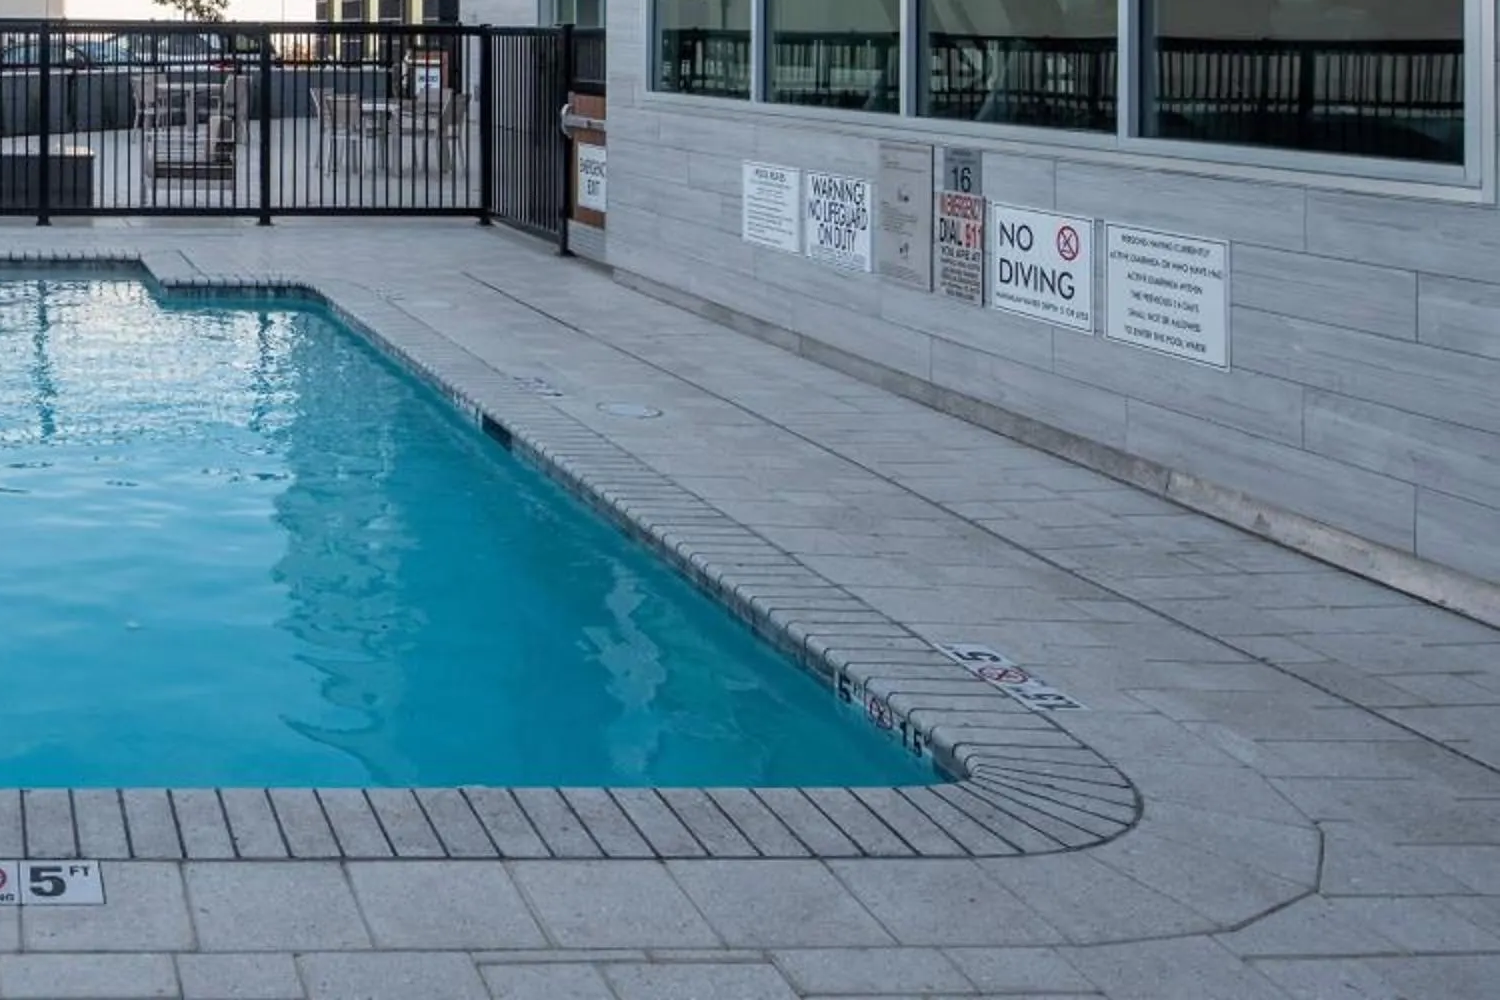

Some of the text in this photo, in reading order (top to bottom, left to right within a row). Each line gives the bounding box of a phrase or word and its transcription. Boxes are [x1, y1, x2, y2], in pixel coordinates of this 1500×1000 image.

[951, 166, 972, 193] 16
[808, 199, 821, 220] NO
[818, 223, 857, 252] ON DUTY
[940, 217, 962, 246] DIAL
[1000, 221, 1033, 251] NO
[1000, 257, 1075, 300] DIVING
[29, 866, 90, 897] 5 FT
